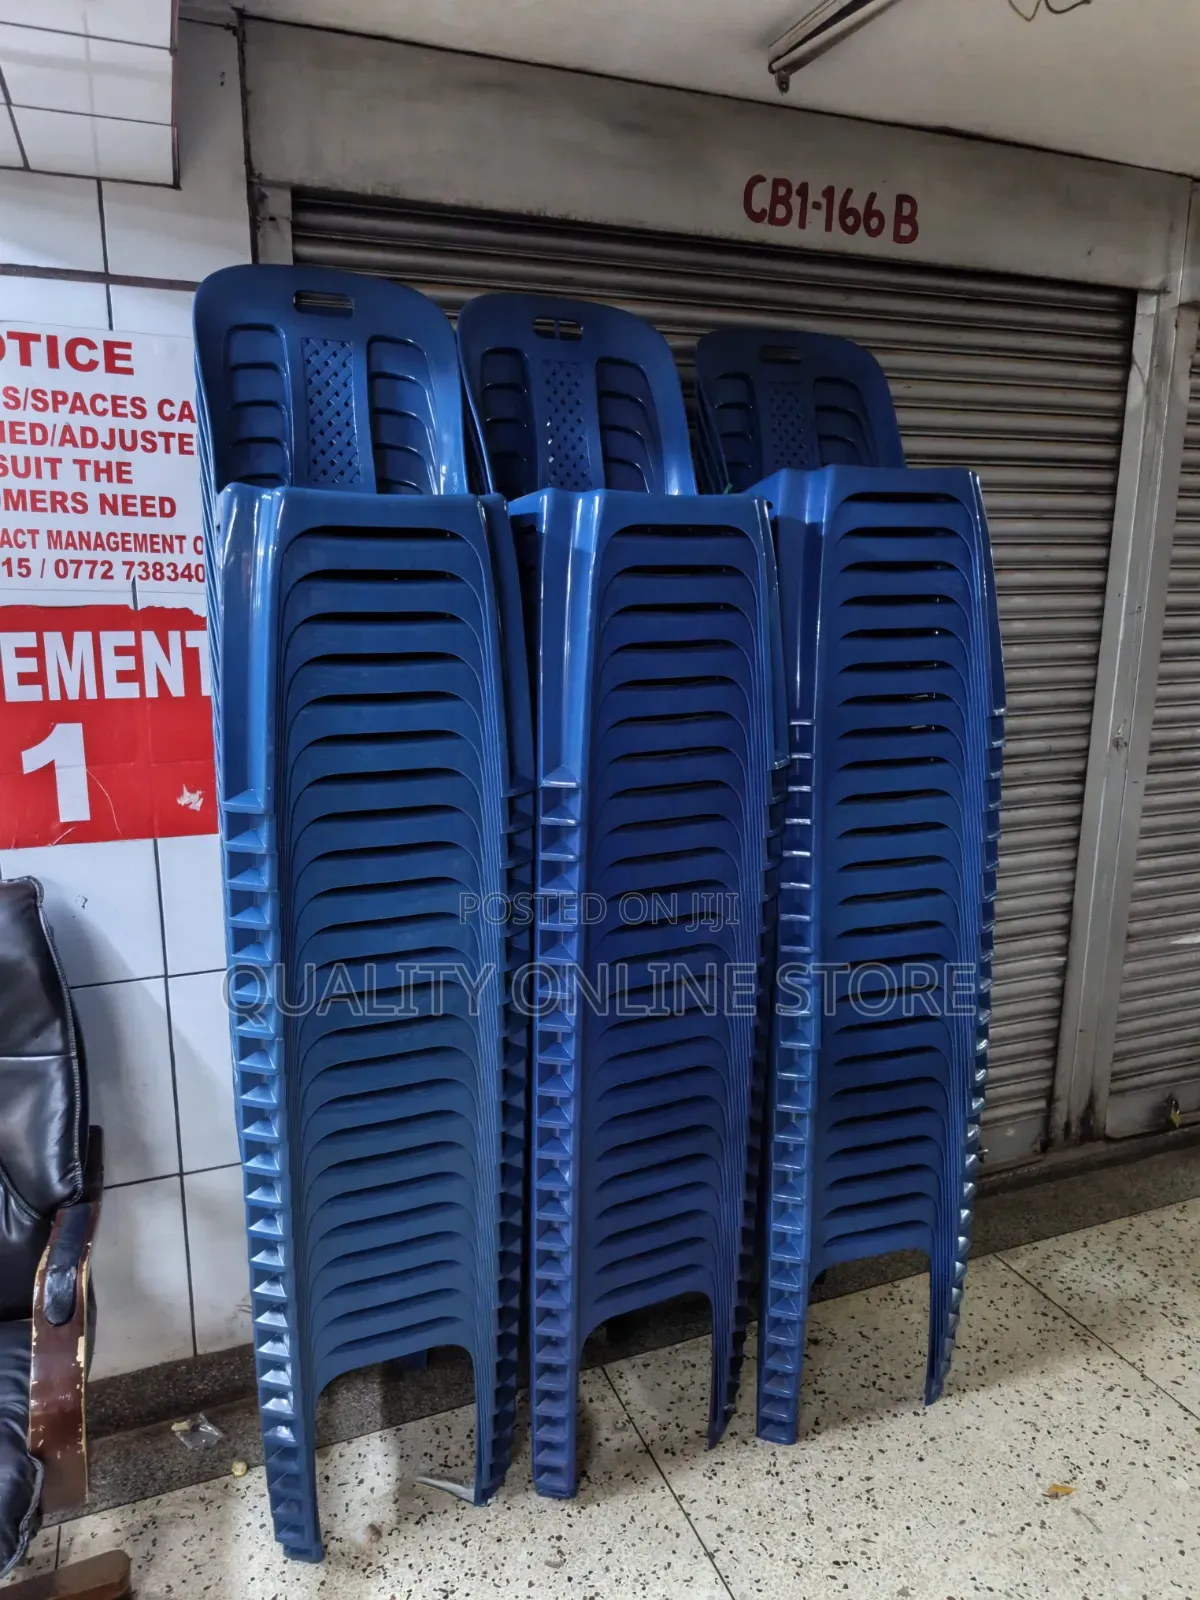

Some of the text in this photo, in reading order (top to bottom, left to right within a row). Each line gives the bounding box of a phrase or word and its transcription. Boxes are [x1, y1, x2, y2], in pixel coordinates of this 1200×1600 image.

[743, 174, 919, 244] CB1-166 B
[0, 331, 135, 376] TICE
[2, 386, 197, 424] S/SPACES CA
[72, 458, 133, 484] THE
[0, 488, 177, 518] MERS NEED
[0, 528, 40, 550] ACT
[46, 529, 187, 555] MANAGEMENT
[1, 556, 206, 583] 15 / 0772 738340
[0, 630, 212, 703] EMENT
[21, 722, 91, 823] 1
